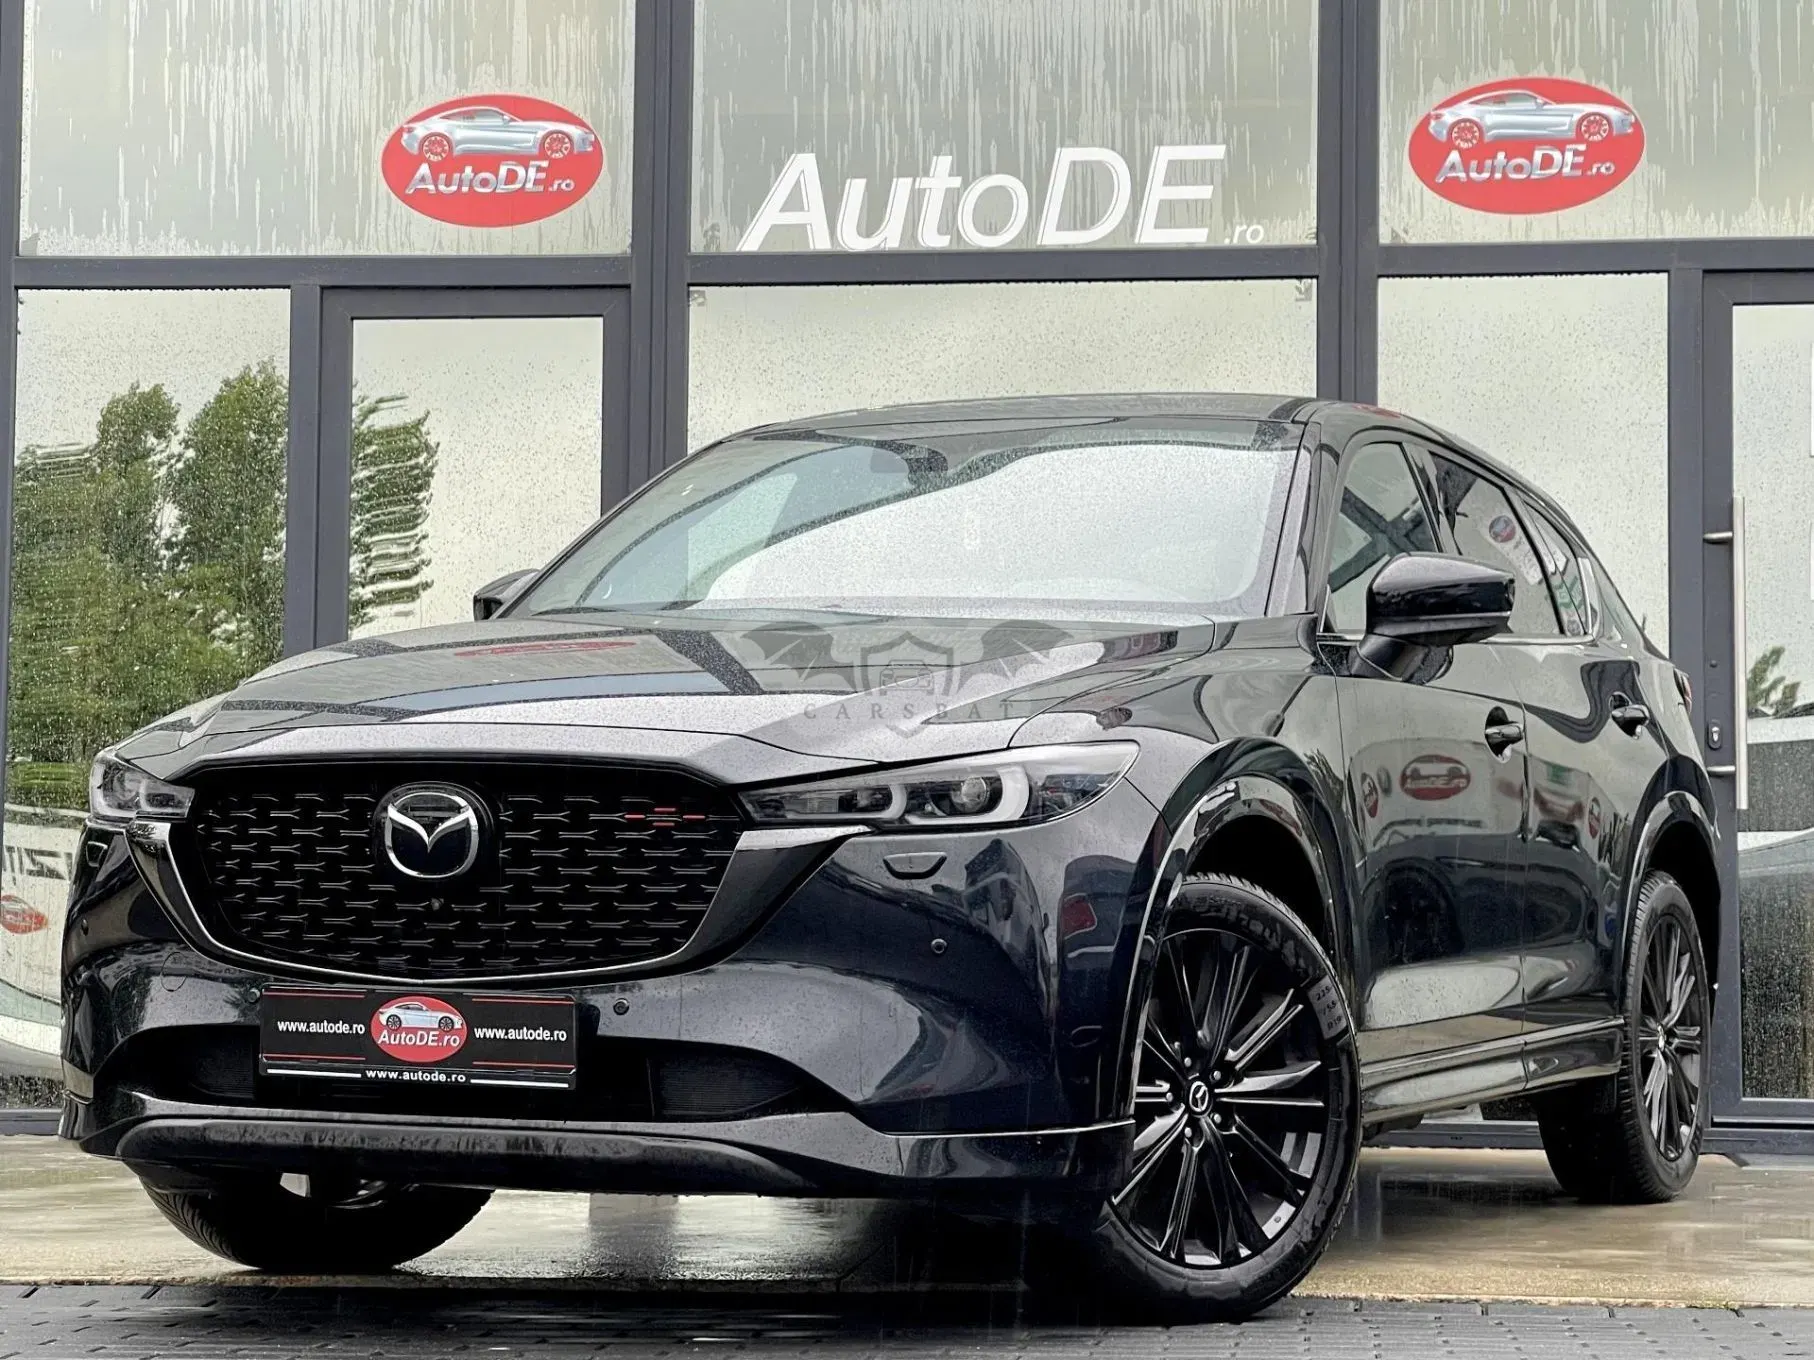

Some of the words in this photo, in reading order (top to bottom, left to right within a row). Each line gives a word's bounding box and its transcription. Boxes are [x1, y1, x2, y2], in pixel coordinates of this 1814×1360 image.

[1435, 144, 1615, 183] AutoDE.ro
[405, 160, 575, 194] AutoDE.ro
[736, 144, 1264, 252] AutoDE.ro
[277, 1019, 366, 1035] www.autode.ro
[474, 1026, 568, 1042] www.autode.ro
[377, 1030, 461, 1048] AutoDE.ro
[366, 1068, 466, 1083] www.autode.ro
